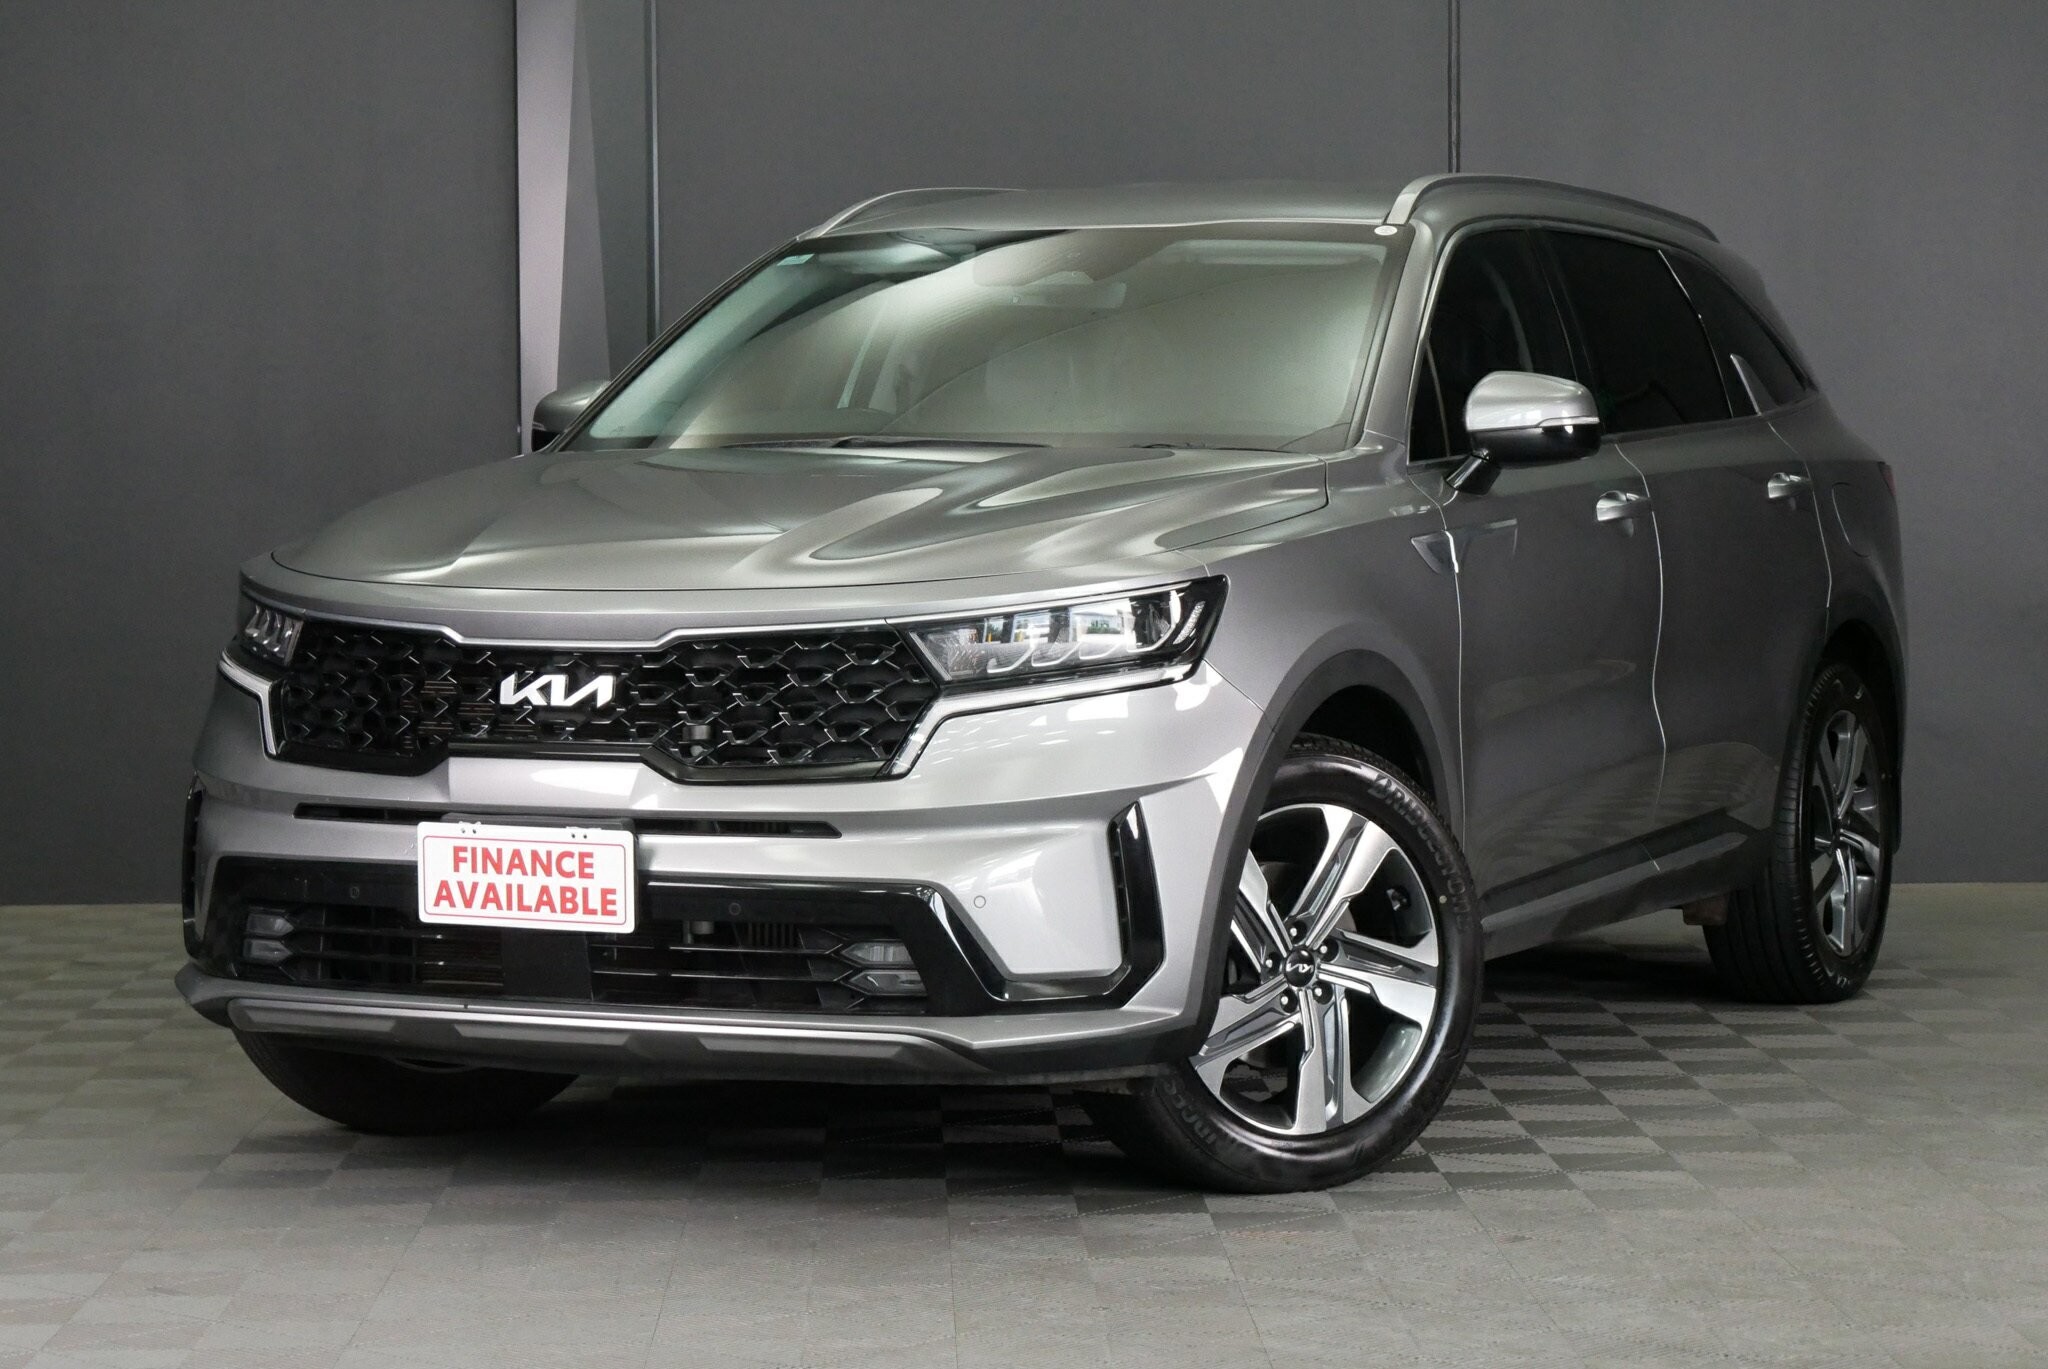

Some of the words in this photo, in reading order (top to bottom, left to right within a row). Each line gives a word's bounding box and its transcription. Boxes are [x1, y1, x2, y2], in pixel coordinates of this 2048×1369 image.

[500, 671, 616, 708] KIA
[453, 846, 595, 879] FINANCE
[433, 880, 618, 917] AVAILABLE
